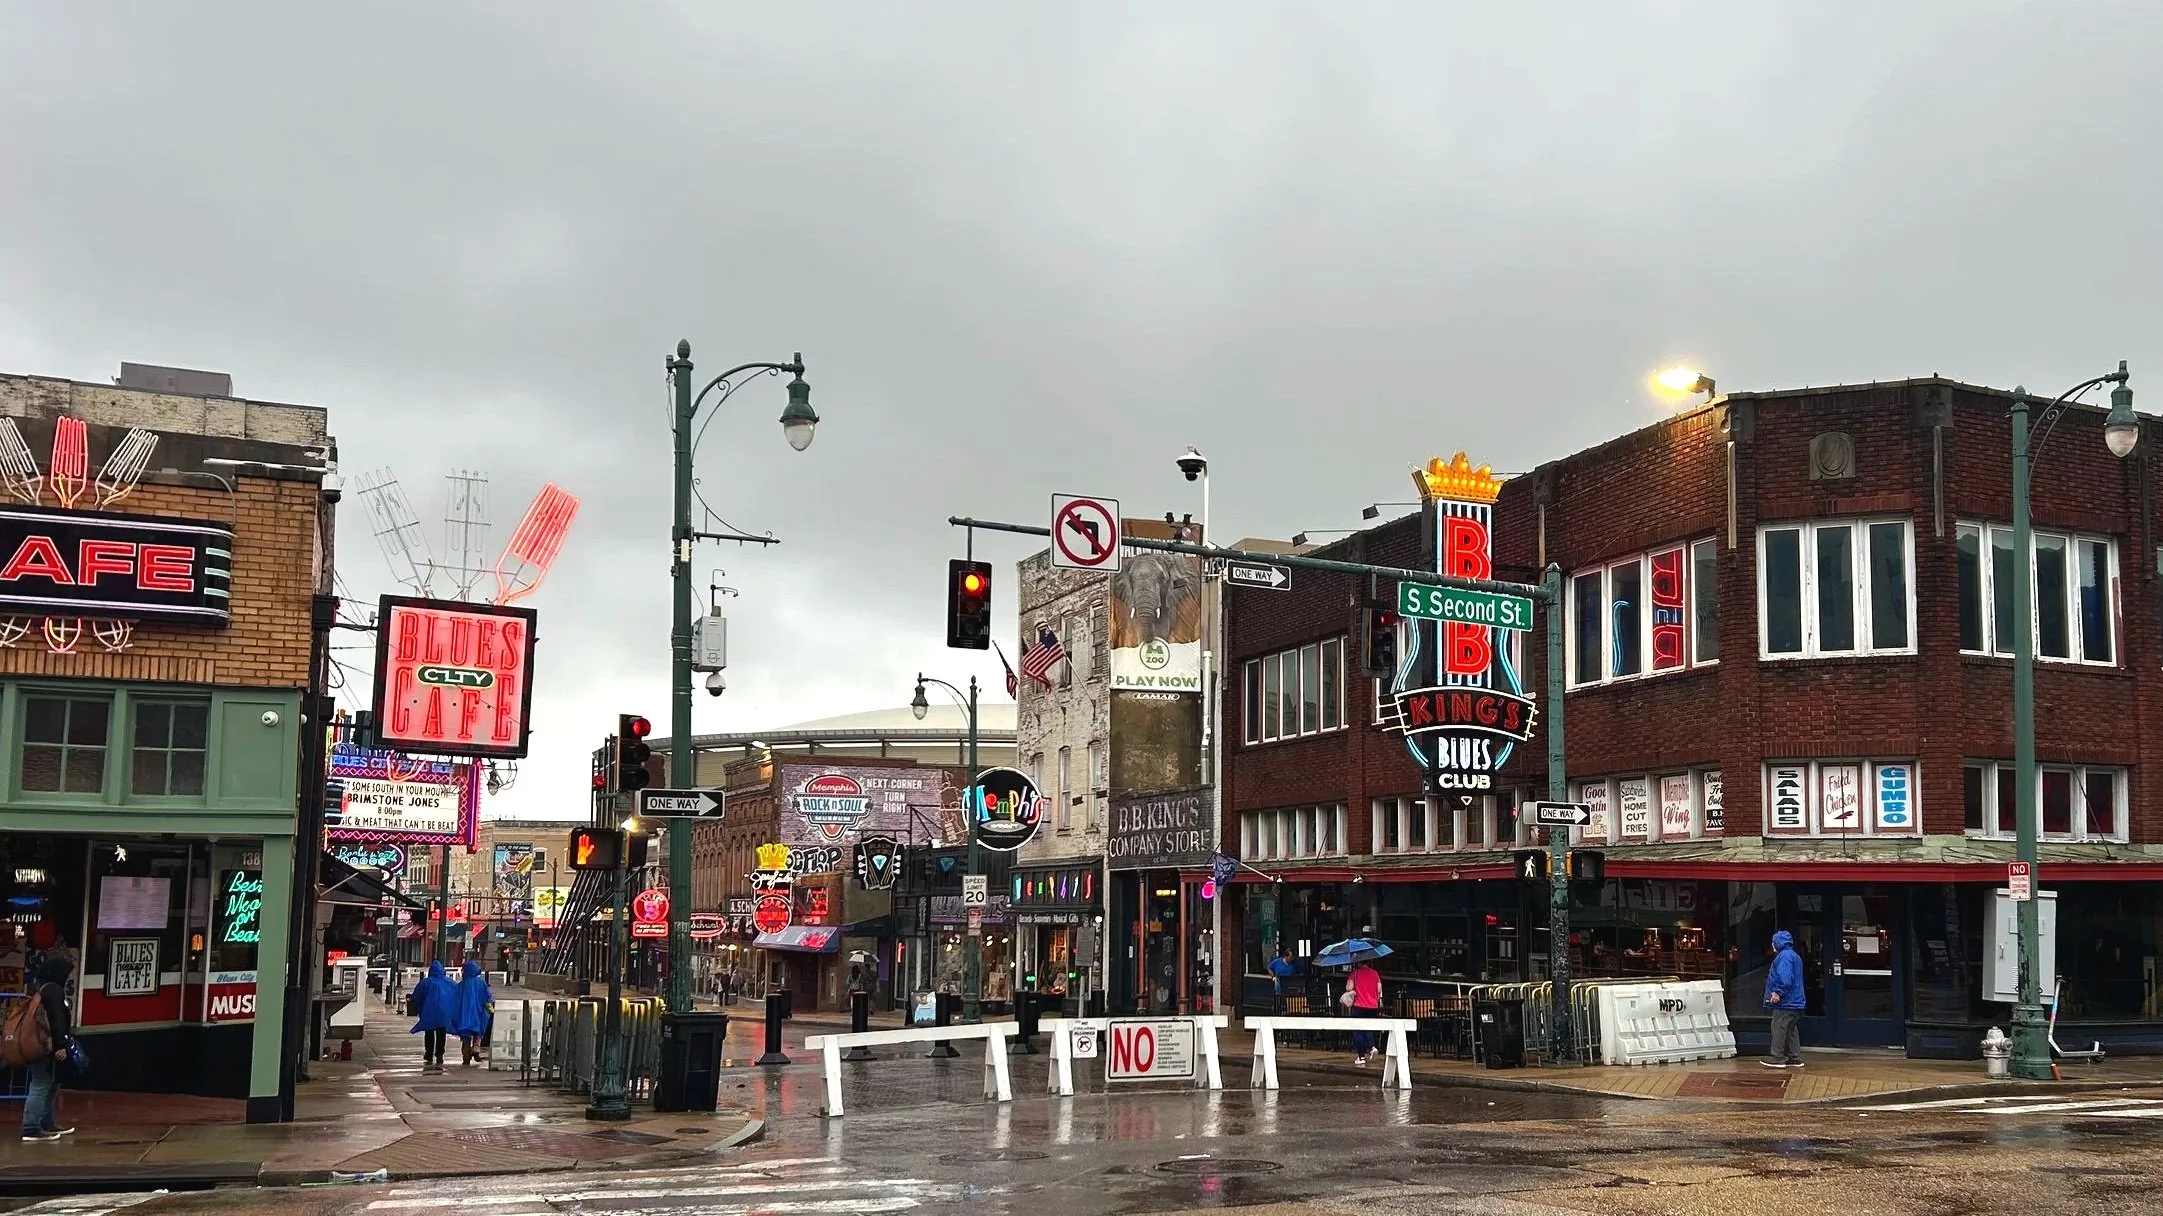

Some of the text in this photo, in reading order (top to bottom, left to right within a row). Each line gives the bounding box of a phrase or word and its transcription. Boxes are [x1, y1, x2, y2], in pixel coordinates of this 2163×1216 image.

[0, 535, 195, 592] AFE
[1235, 569, 1272, 581] ONE WAY
[1407, 588, 1525, 627] S. Second St.
[397, 612, 520, 670] BLUES
[1146, 656, 1164, 664] ZOO
[423, 668, 488, 684] CITY
[1116, 675, 1198, 688] PLAY NOW
[390, 664, 515, 742] CAFE
[1409, 693, 1520, 731] KING'S
[1438, 736, 1492, 770] BLUES
[811, 782, 856, 794] Memphis
[867, 778, 923, 790] NEXT CORNER
[1438, 773, 1491, 789] CLUB
[1828, 770, 1851, 792] Fried
[352, 782, 370, 792] SOME
[372, 783, 394, 793] SOUTH
[396, 784, 403, 794] IN
[406, 785, 423, 795] YOUR
[1880, 767, 1908, 824] GUMBO
[348, 793, 440, 808] BRIMSTONE JONES
[650, 798, 699, 809] ONE WAY
[885, 792, 906, 802] TURN
[1776, 769, 1801, 825] SALADS
[1826, 793, 1857, 815] Chicken
[803, 798, 831, 811] ROCK
[839, 799, 863, 812] SOUL
[883, 803, 907, 814] RIGHT
[1624, 802, 1647, 811] HOME
[1541, 808, 1575, 819] ONE WAY
[1626, 812, 1647, 821] CUT
[355, 817, 360, 825] &
[363, 817, 382, 827] MEAT
[385, 818, 402, 828] THAT
[428, 821, 435, 829] BE
[438, 821, 455, 831] BEAT
[1626, 823, 1648, 833] FRIES
[1109, 828, 1210, 857] COMPANY STORE
[241, 852, 260, 866] 138
[2012, 865, 2026, 874] NO
[966, 891, 985, 903] 20
[115, 943, 154, 963] BLUES
[114, 962, 152, 990] CAFE
[1659, 998, 1684, 1012] MPD
[1113, 1027, 1155, 1072] NO
